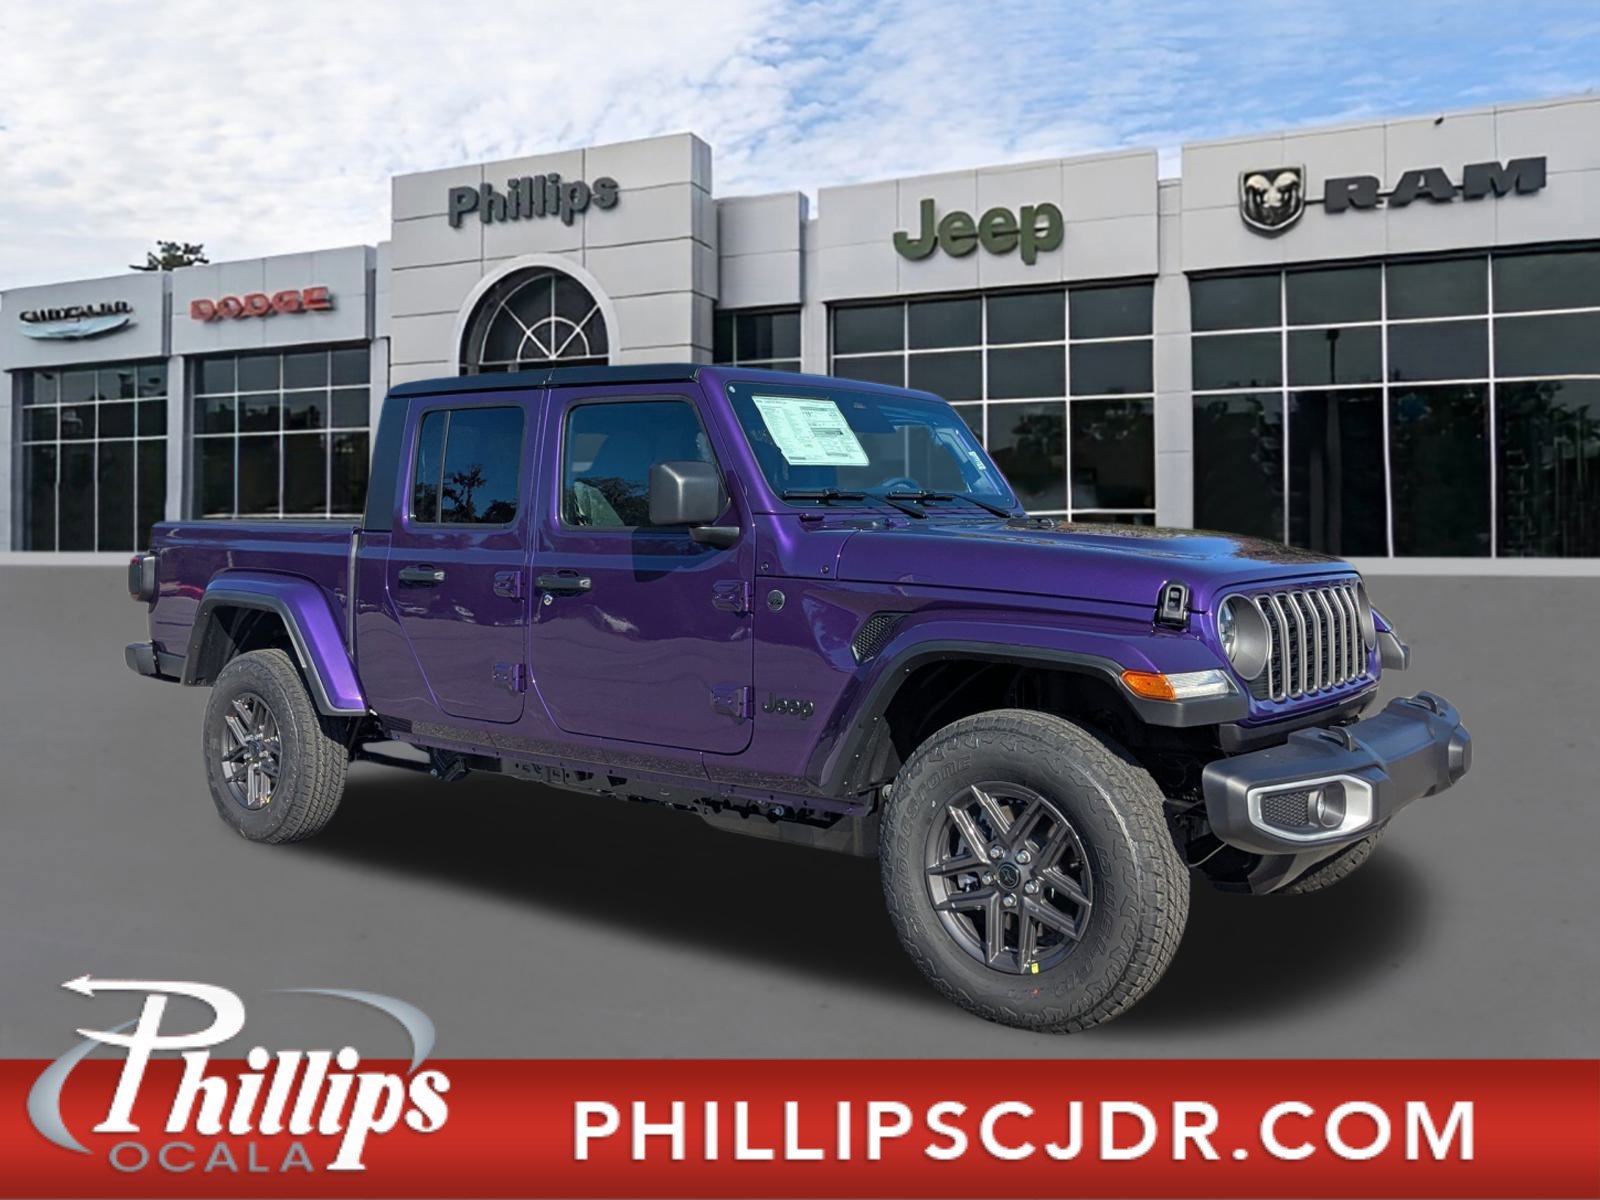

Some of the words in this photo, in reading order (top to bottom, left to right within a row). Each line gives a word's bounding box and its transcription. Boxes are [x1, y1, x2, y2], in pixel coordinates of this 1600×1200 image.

[448, 172, 620, 229] Phillips
[1324, 156, 1547, 213] RAM
[893, 198, 1064, 266] Jeep
[191, 286, 332, 322] DODGE
[761, 692, 815, 720] Jeep
